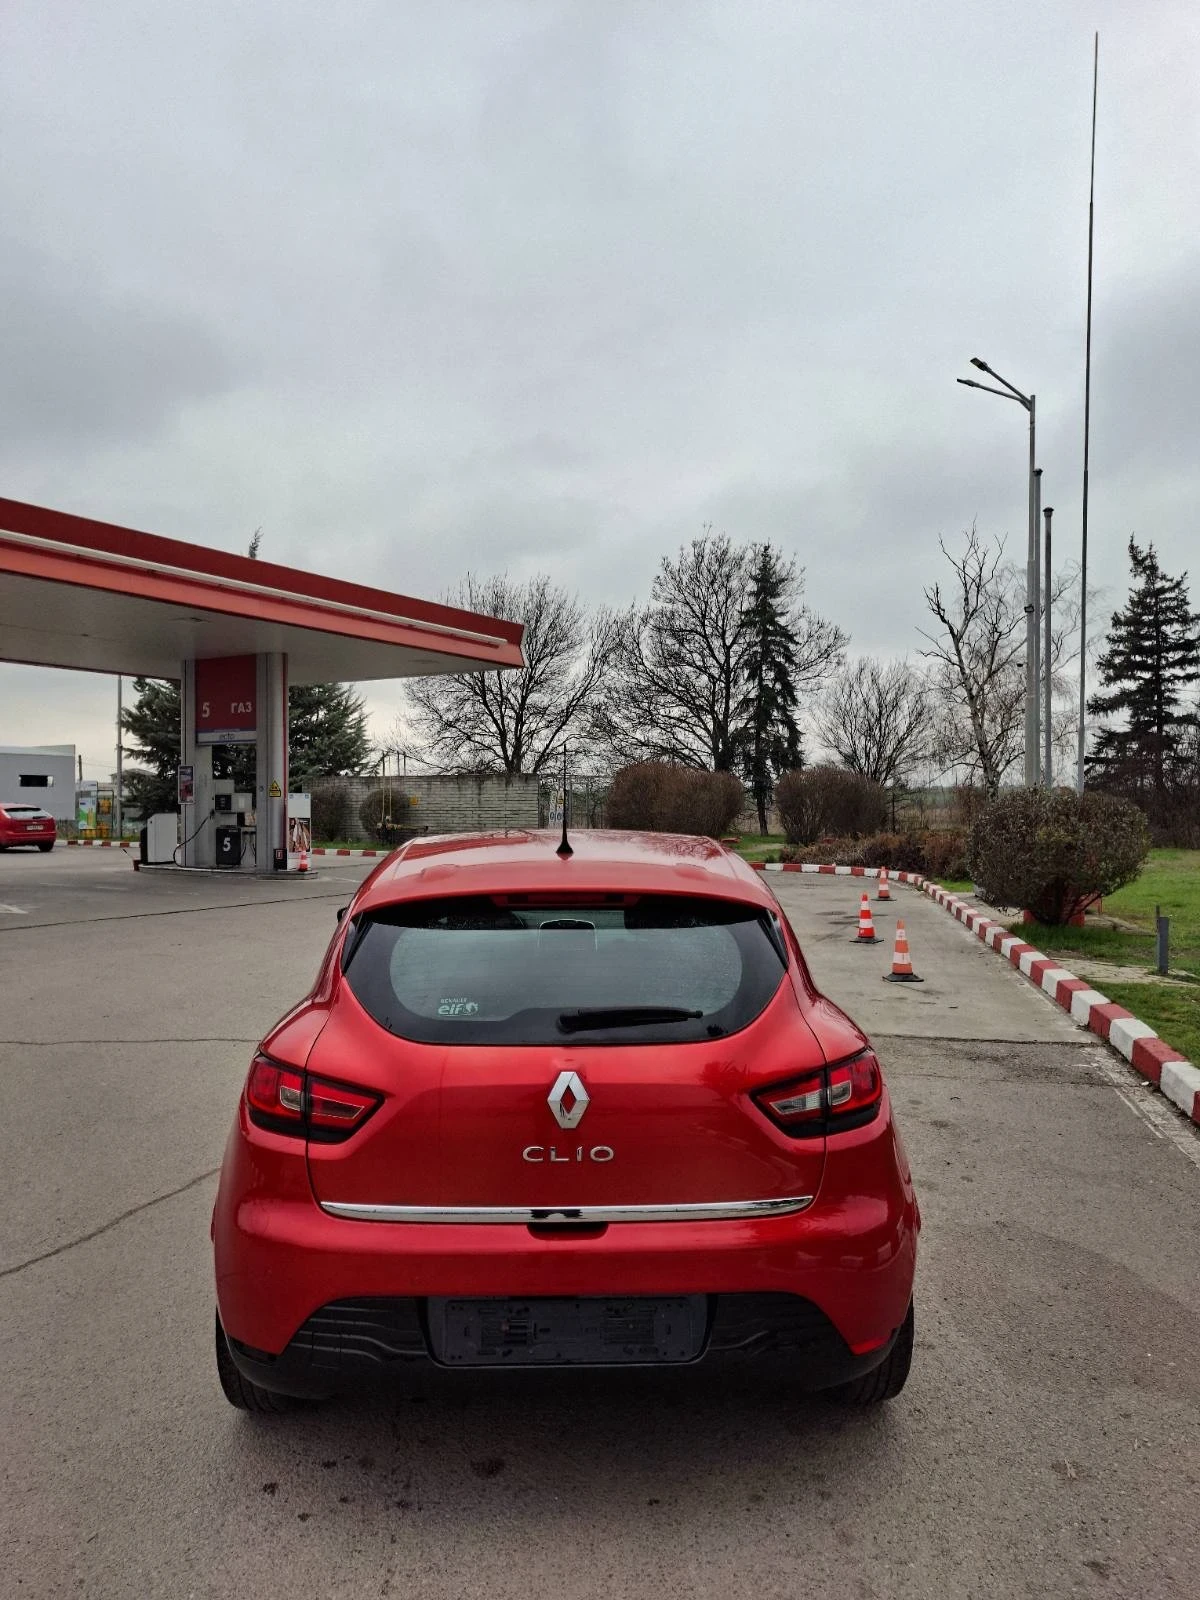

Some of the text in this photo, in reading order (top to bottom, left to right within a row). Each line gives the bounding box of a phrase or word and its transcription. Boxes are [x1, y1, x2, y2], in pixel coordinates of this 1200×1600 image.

[202, 701, 252, 718] 5 ГАЗ
[223, 837, 231, 852] 5
[438, 1003, 465, 1015] elf
[522, 1146, 615, 1162] CLIO
